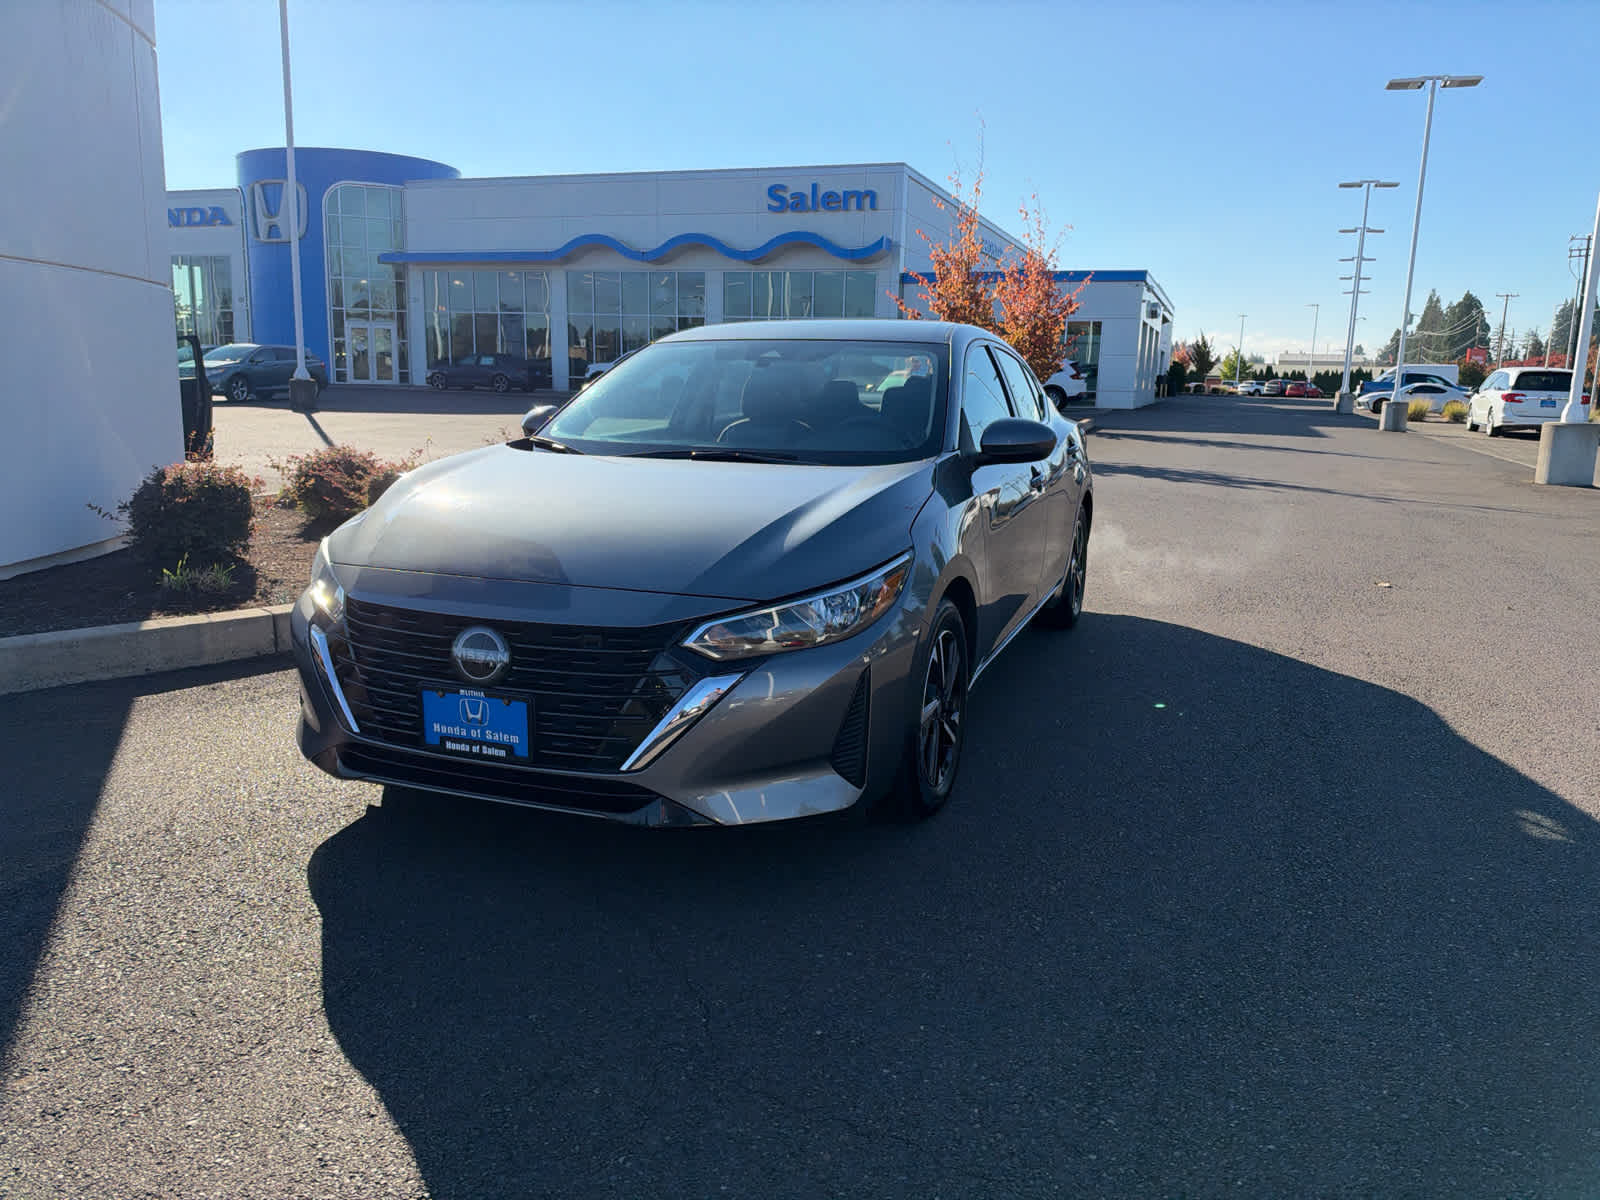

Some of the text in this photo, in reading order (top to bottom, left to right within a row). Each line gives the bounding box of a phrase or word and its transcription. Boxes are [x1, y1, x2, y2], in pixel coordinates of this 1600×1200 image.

[767, 182, 878, 213] Salem
[433, 722, 519, 744] Honda of Salem
[445, 740, 506, 757] Honda of Salem
